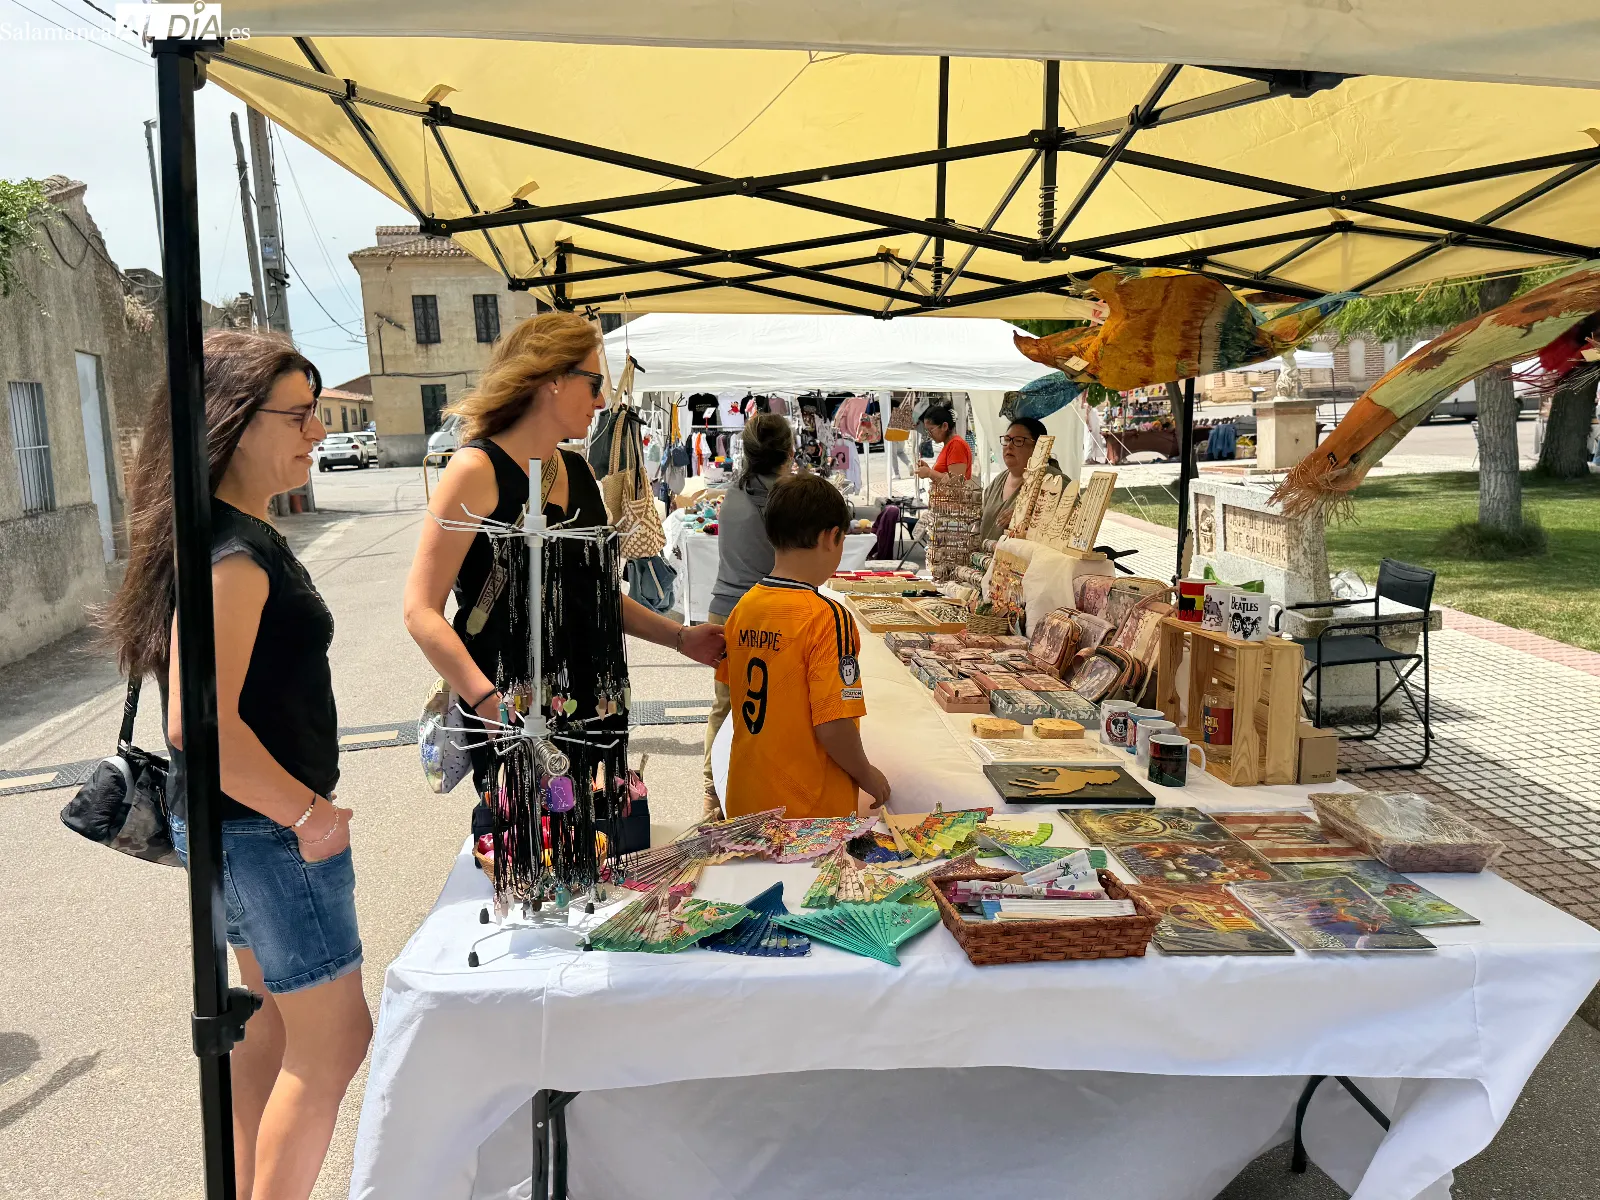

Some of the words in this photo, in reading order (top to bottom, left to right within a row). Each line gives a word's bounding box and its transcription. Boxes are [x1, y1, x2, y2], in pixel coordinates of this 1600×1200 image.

[1231, 596, 1258, 613] BEATLES
[739, 629, 782, 651] MBAPPÉ
[742, 656, 769, 735] 9
